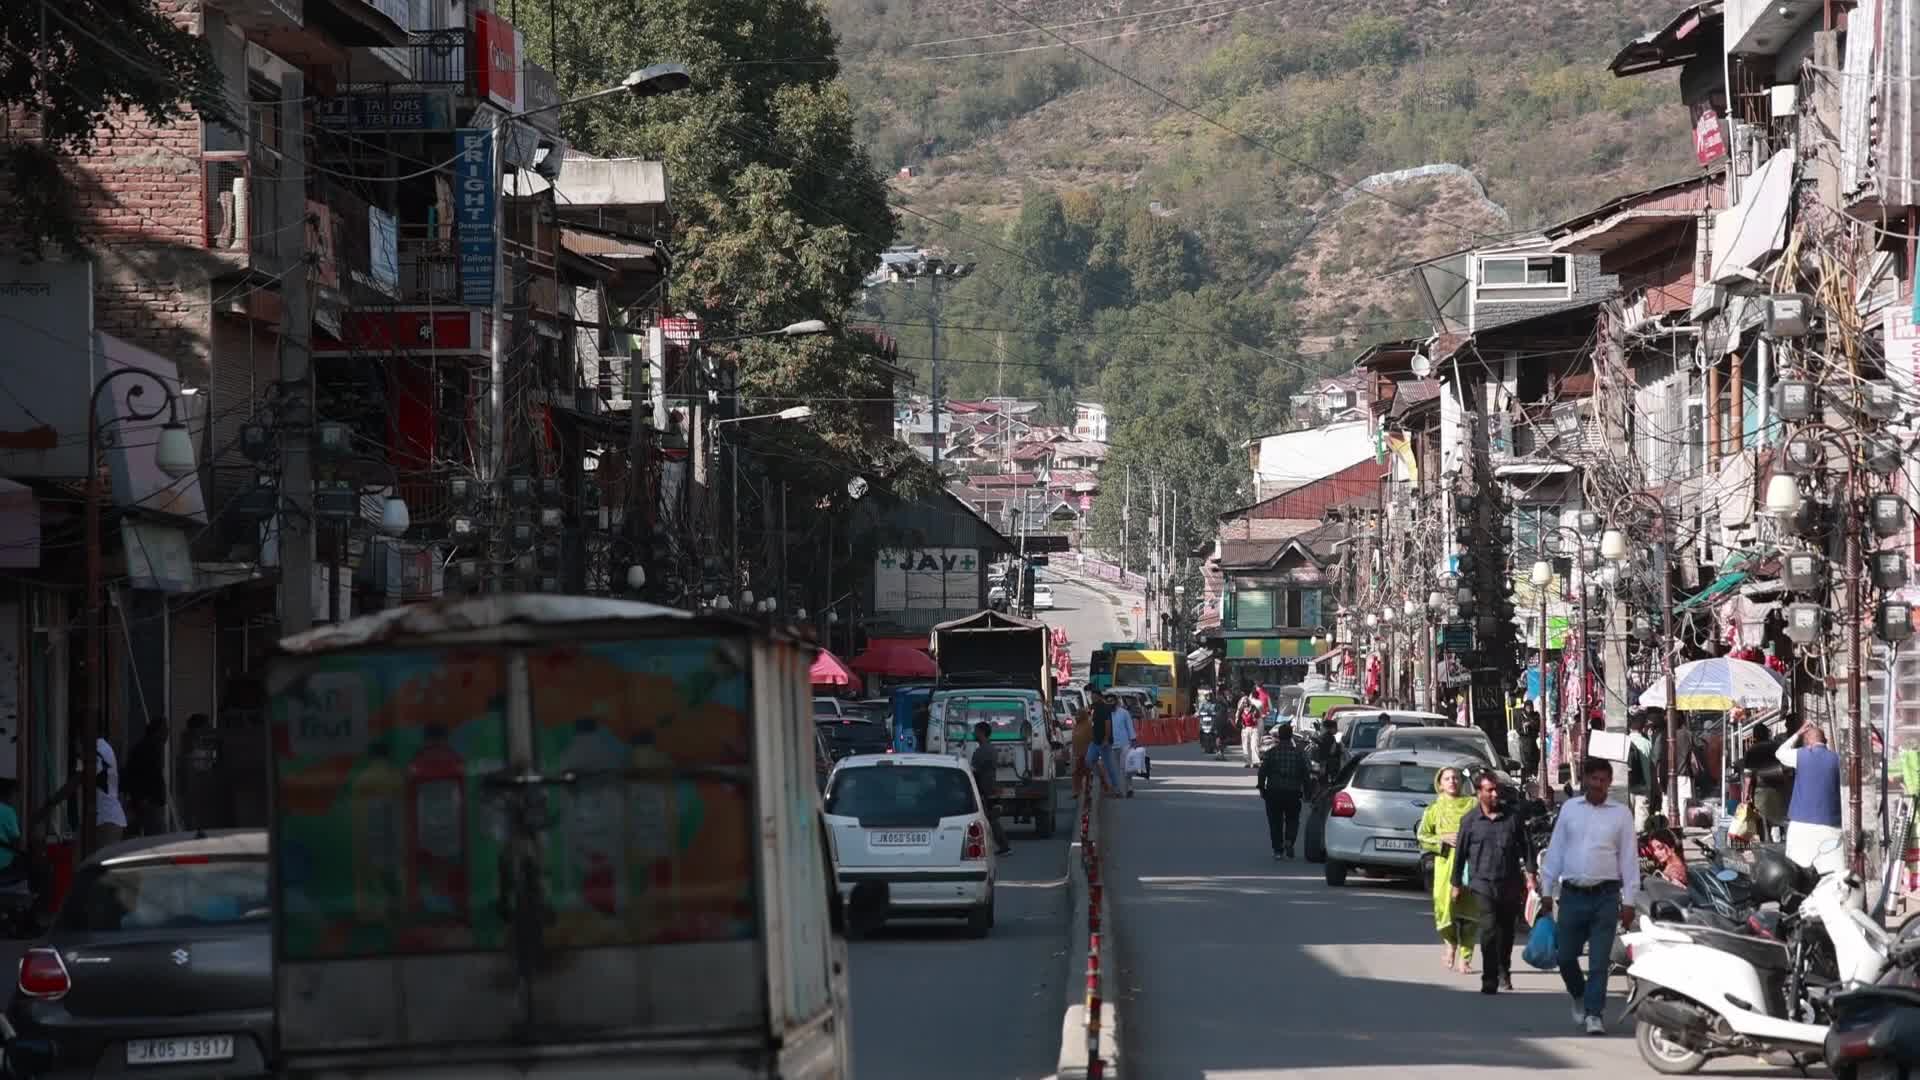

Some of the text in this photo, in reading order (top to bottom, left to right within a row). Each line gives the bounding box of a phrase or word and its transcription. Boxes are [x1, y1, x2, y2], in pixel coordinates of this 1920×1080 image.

[367, 101, 420, 112] TAIORS
[464, 136, 484, 220] BRIGHT
[1259, 657, 1283, 666] ZERO
